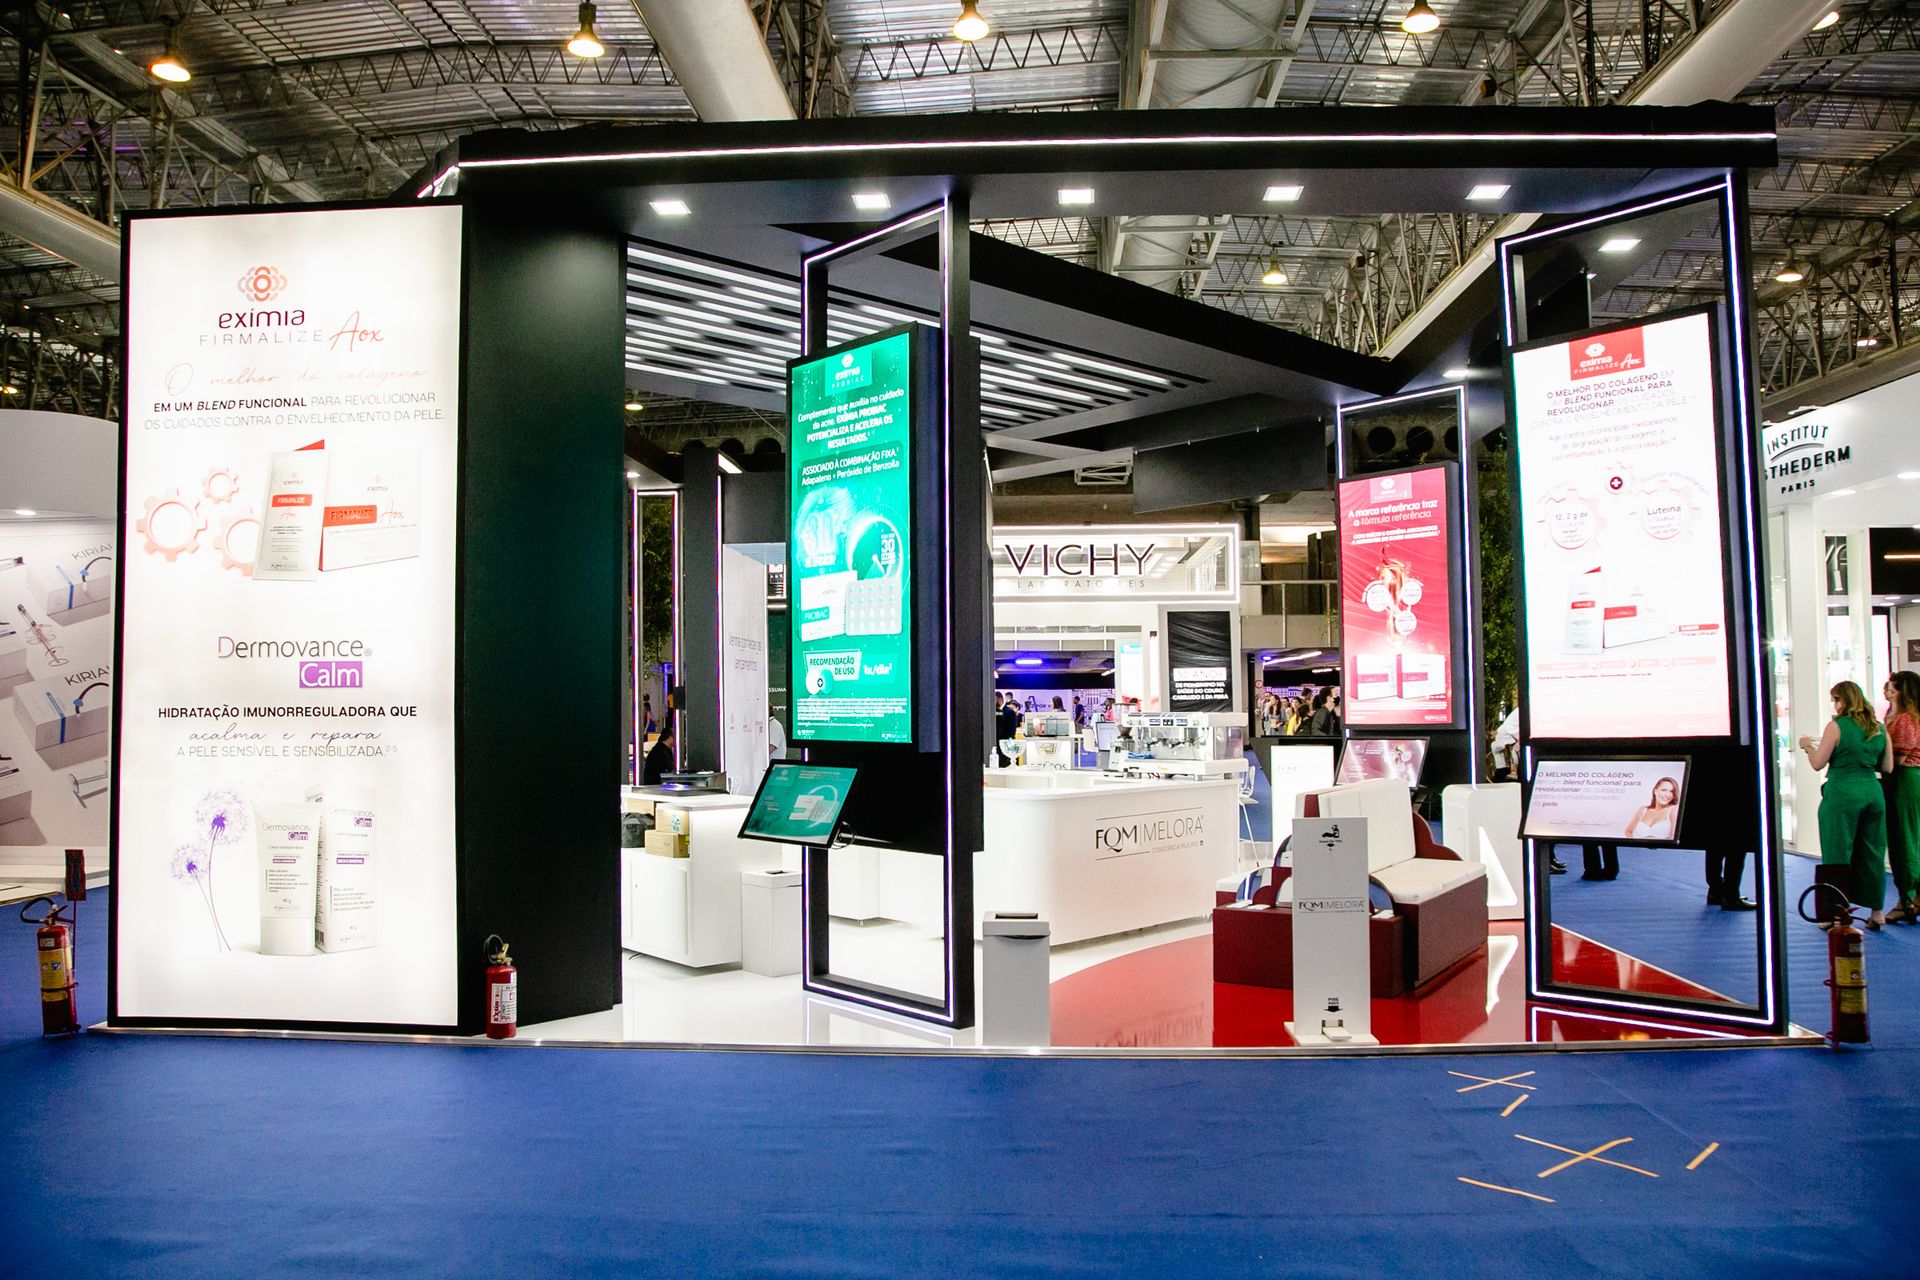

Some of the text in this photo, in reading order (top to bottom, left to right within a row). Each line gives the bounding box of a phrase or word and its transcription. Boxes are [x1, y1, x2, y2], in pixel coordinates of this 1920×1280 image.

[199, 310, 385, 352] FIRMALIZE Aox
[1574, 361, 1619, 374] FIRMALIZE
[164, 362, 194, 397] O
[210, 366, 281, 386] melhor
[870, 396, 879, 404] no
[879, 388, 904, 402] cuidado
[1546, 391, 1553, 399] O
[1555, 384, 1591, 399] MELHOR
[1593, 382, 1606, 391] DO
[1564, 393, 1593, 406] BLEND
[1594, 384, 1645, 400] FUNCIONAL
[1647, 379, 1673, 391] PARA
[153, 392, 436, 413] EM UM BLEND FUNCIONAL PARA REVOLUCIONAR
[1547, 399, 1615, 417] REVOLUCIONAR
[144, 419, 160, 431] OS
[163, 416, 221, 430] CUIDADOS
[224, 414, 272, 428] CONTRA
[275, 414, 285, 426] O
[287, 410, 391, 425] ENVELHECIMENTO
[394, 409, 411, 422] DA
[807, 415, 894, 443] POTENCIALIZA E ACELERA OS
[1767, 424, 1829, 455] INSTITUT
[802, 461, 834, 476] ASSOCIADO
[840, 451, 881, 468] COMBINAÇÃO
[864, 465, 872, 473] de
[1780, 479, 1815, 494] PARIS
[1348, 499, 1439, 518] A marca referência traz
[1361, 514, 1391, 526] fórmula
[1005, 543, 1155, 576] VICHY
[809, 655, 855, 667] RECOMENDAÇÃO
[300, 661, 360, 688] Calm
[834, 667, 855, 676] DE USO
[158, 703, 417, 721] HIDRATAÇÃO IMUNORREGULADORA QUE
[189, 722, 382, 750] acalma e repara
[176, 746, 185, 758] A
[189, 746, 218, 758] PELE
[222, 743, 279, 758] SENSÍVEL
[282, 746, 289, 758] E
[1095, 825, 1138, 853] FQM
[1299, 901, 1323, 912] FQM
